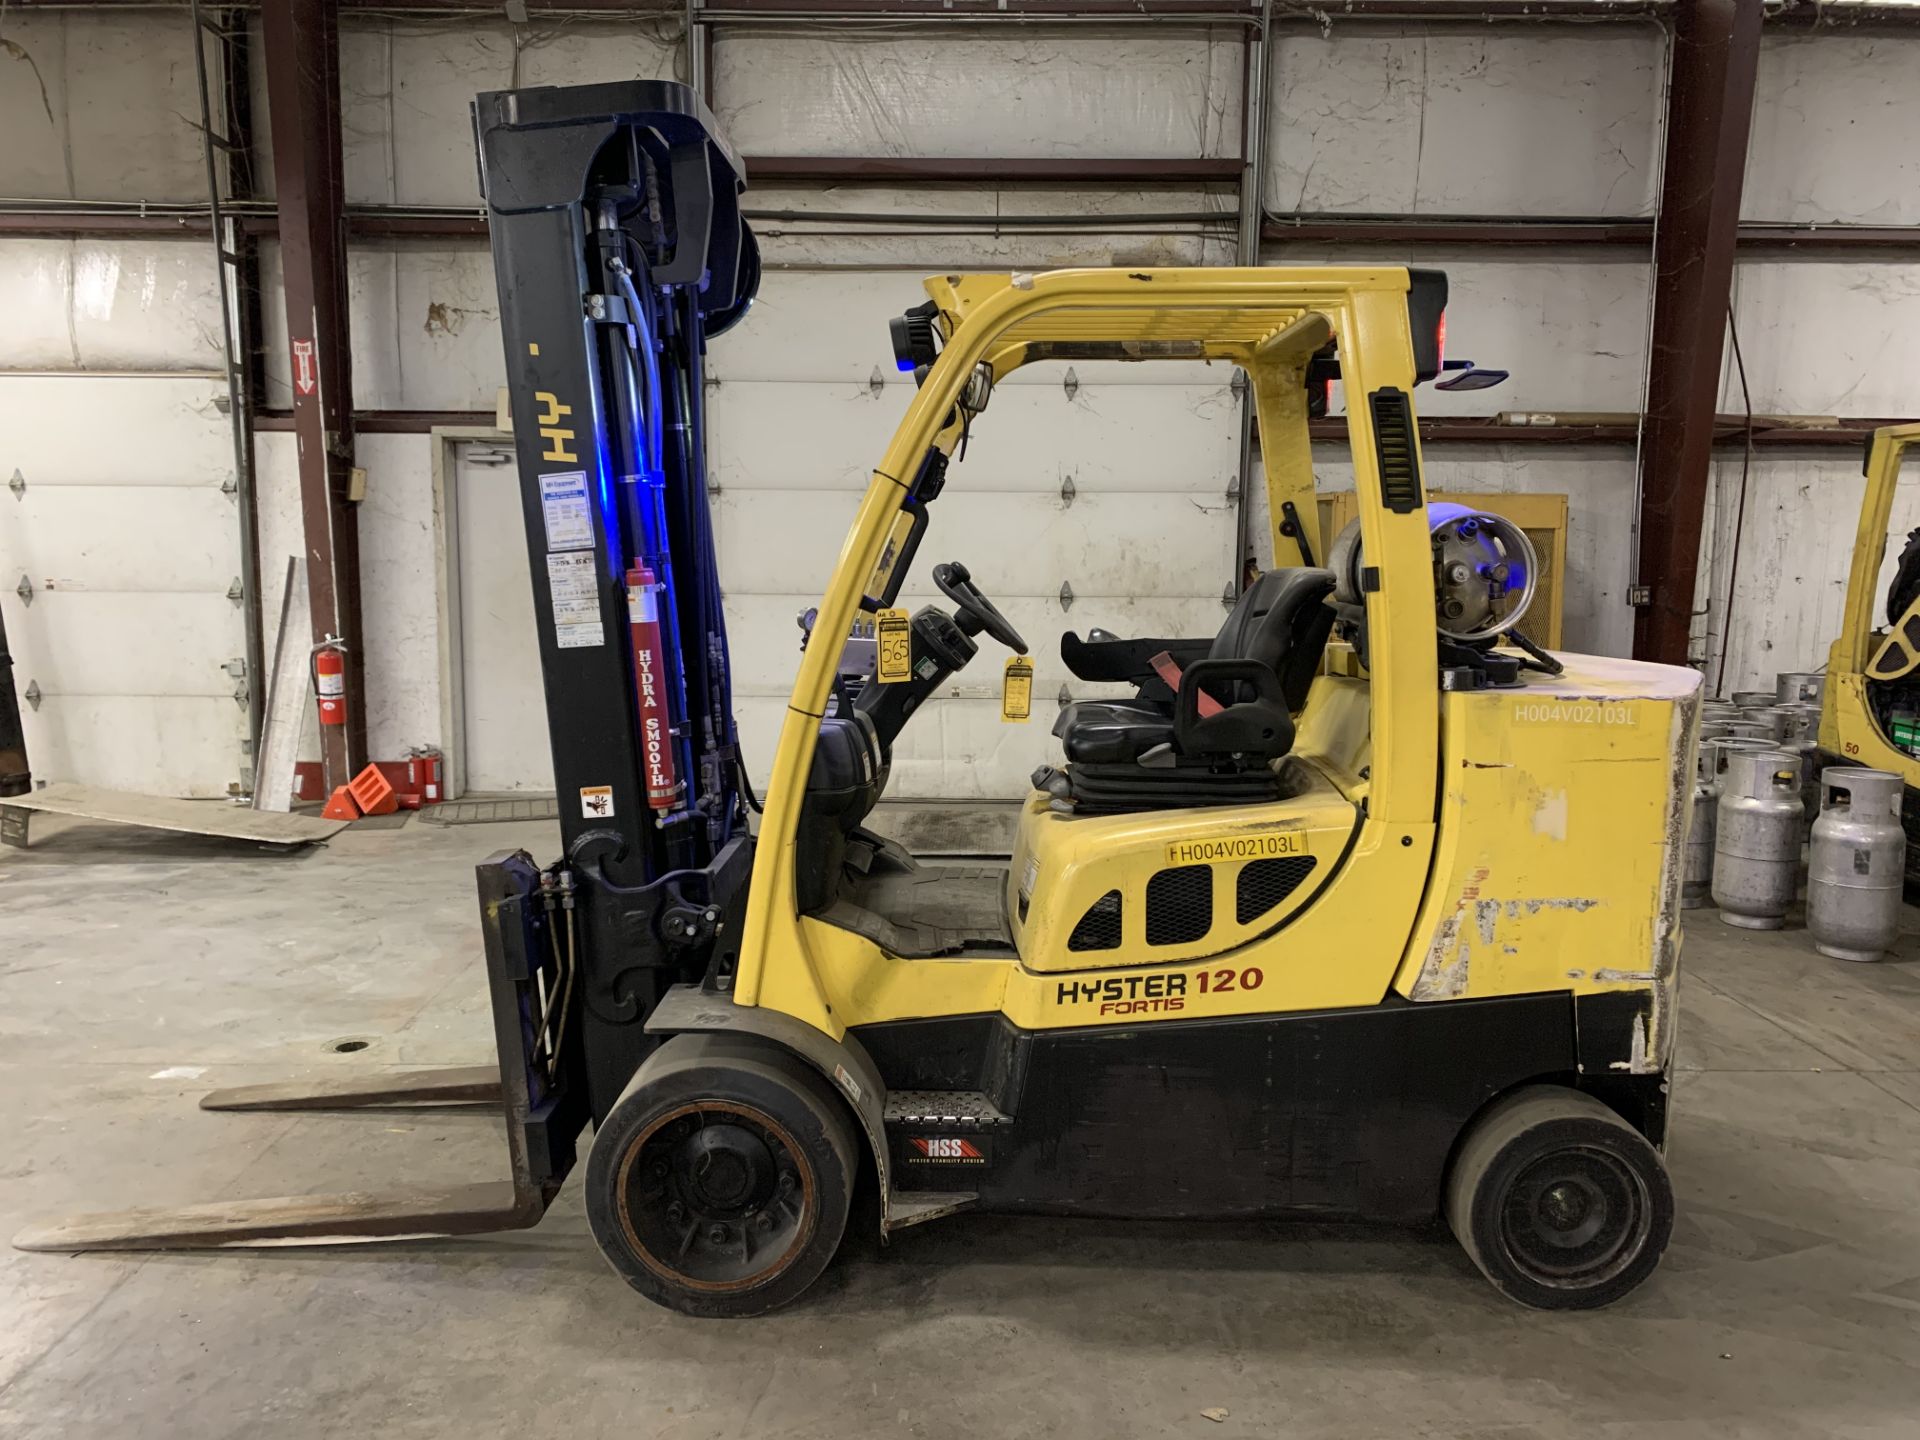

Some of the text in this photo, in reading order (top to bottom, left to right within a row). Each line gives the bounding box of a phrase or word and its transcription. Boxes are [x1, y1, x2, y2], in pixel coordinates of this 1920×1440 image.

[296, 345, 309, 353] FIRE
[882, 639, 910, 663] 565
[639, 650, 657, 707] HYDRA
[1515, 704, 1636, 725] H004V02103L
[646, 718, 665, 786] SMOOTH
[1845, 741, 1859, 755] 50
[1180, 836, 1299, 862] H004V02103L
[1057, 967, 1264, 1005] HYSTER 120
[1100, 997, 1185, 1016] FORTIS
[927, 1139, 962, 1157] HSS
